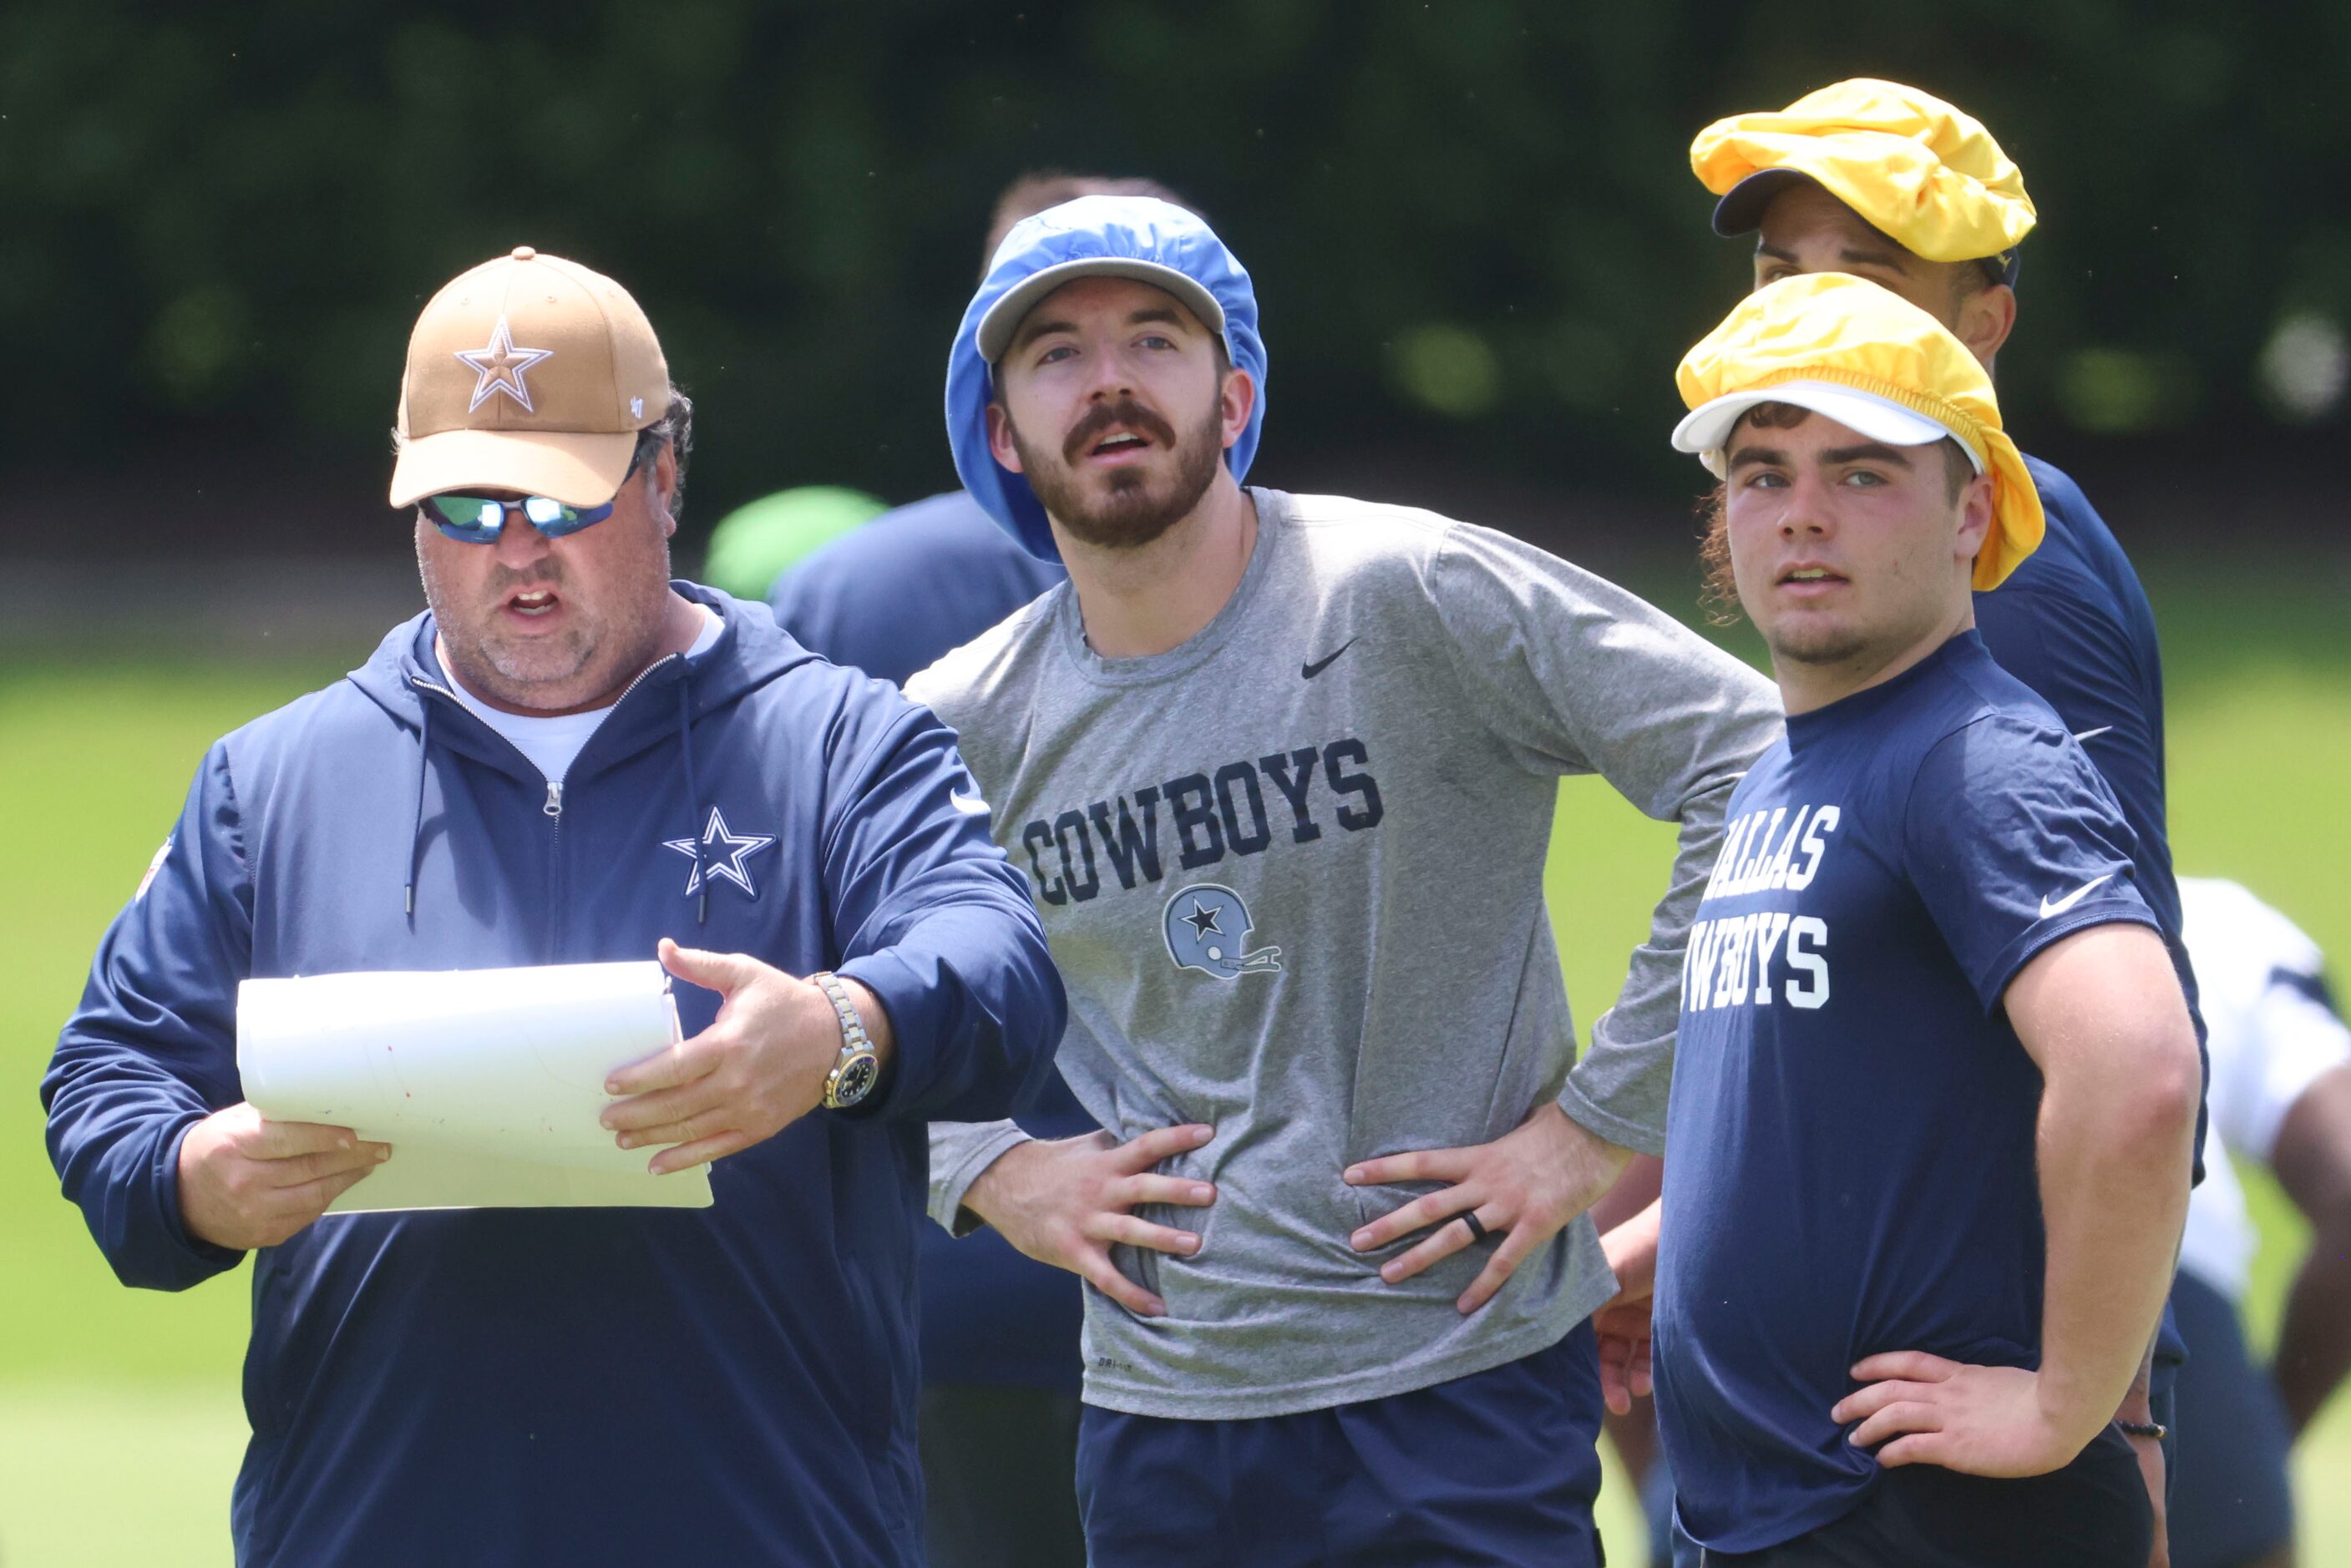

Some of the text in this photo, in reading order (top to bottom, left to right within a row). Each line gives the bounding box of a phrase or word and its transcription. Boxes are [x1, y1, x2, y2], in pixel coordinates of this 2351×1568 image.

[1023, 738, 1384, 905] COWBOYS
[1701, 804, 1841, 902] ALLAS
[1680, 912, 1830, 1012] WBOYS
